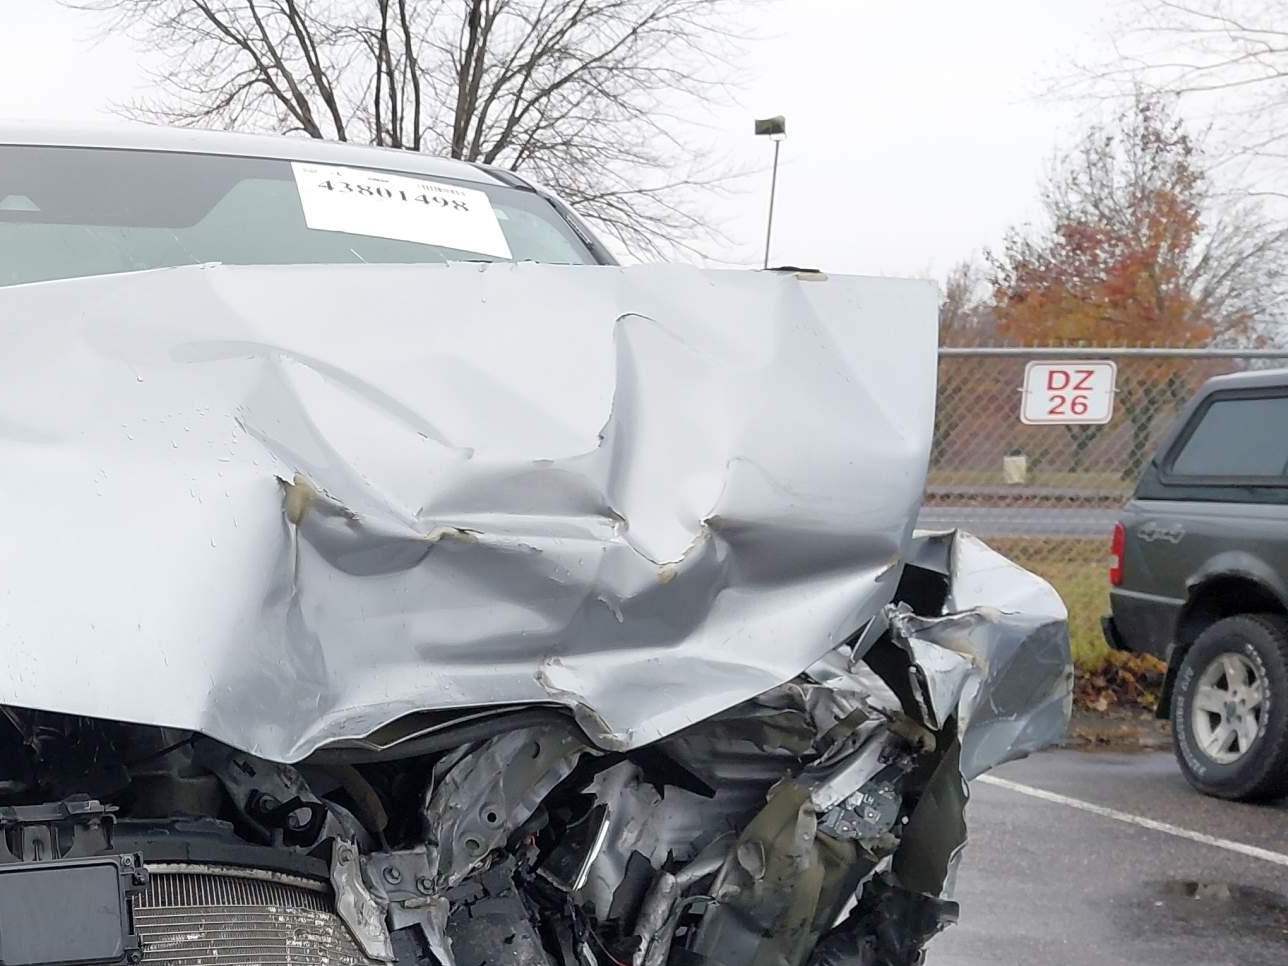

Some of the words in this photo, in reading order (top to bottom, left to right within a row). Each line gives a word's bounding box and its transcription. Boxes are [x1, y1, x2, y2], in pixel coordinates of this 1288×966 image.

[318, 180, 469, 211] 43801498
[1047, 369, 1095, 391] DZ
[1047, 394, 1089, 415] 26
